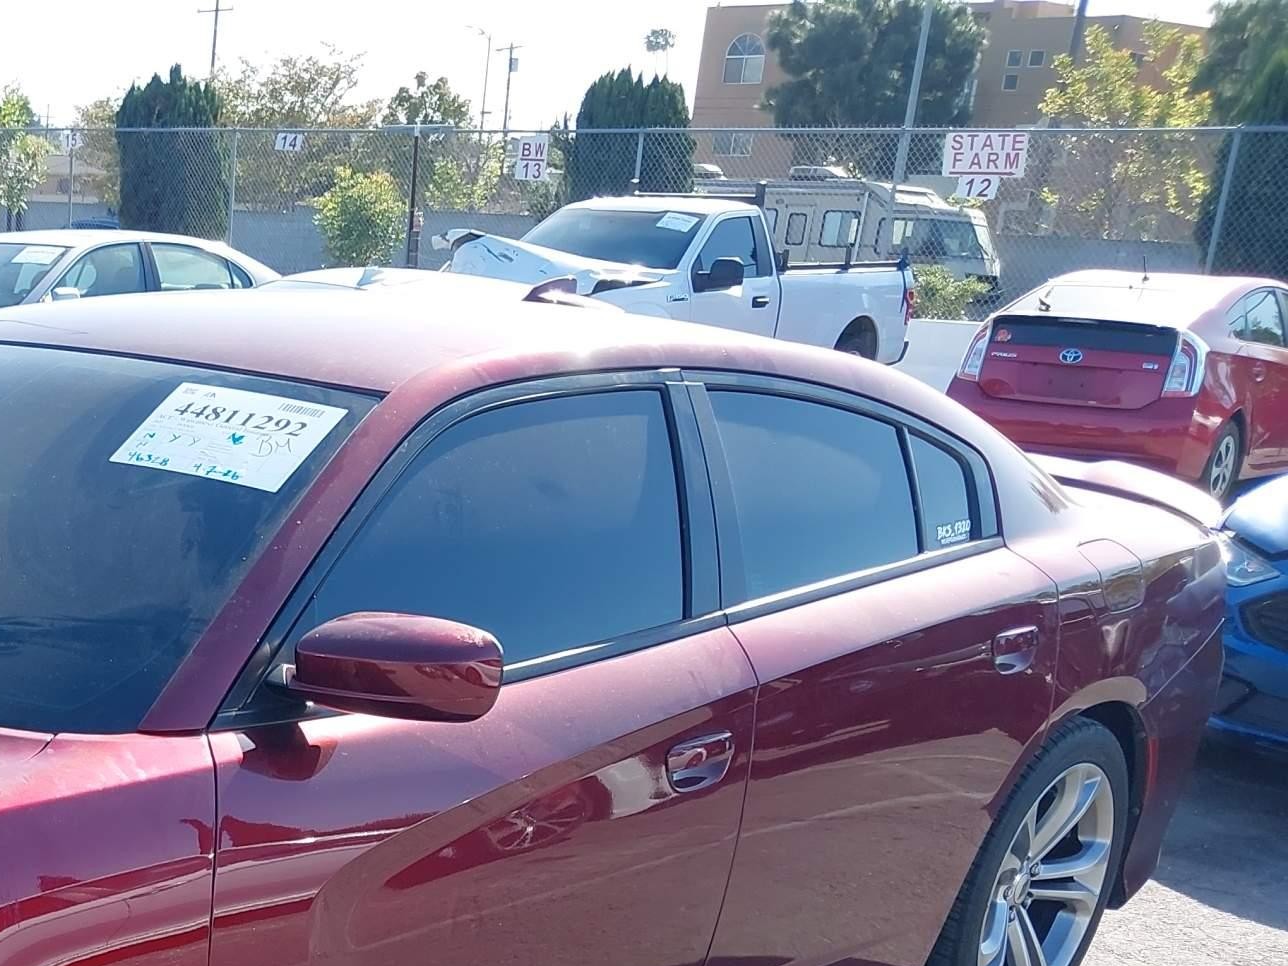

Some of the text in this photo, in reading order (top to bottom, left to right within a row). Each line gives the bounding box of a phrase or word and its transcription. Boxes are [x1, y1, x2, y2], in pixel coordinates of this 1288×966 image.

[65, 133, 78, 148] 15
[280, 135, 297, 150] 14
[951, 133, 1026, 151] STATE
[521, 142, 546, 157] BW
[952, 152, 1020, 170] FARM
[522, 162, 542, 179] 13
[965, 178, 992, 197] 12
[174, 401, 308, 438] 44811292
